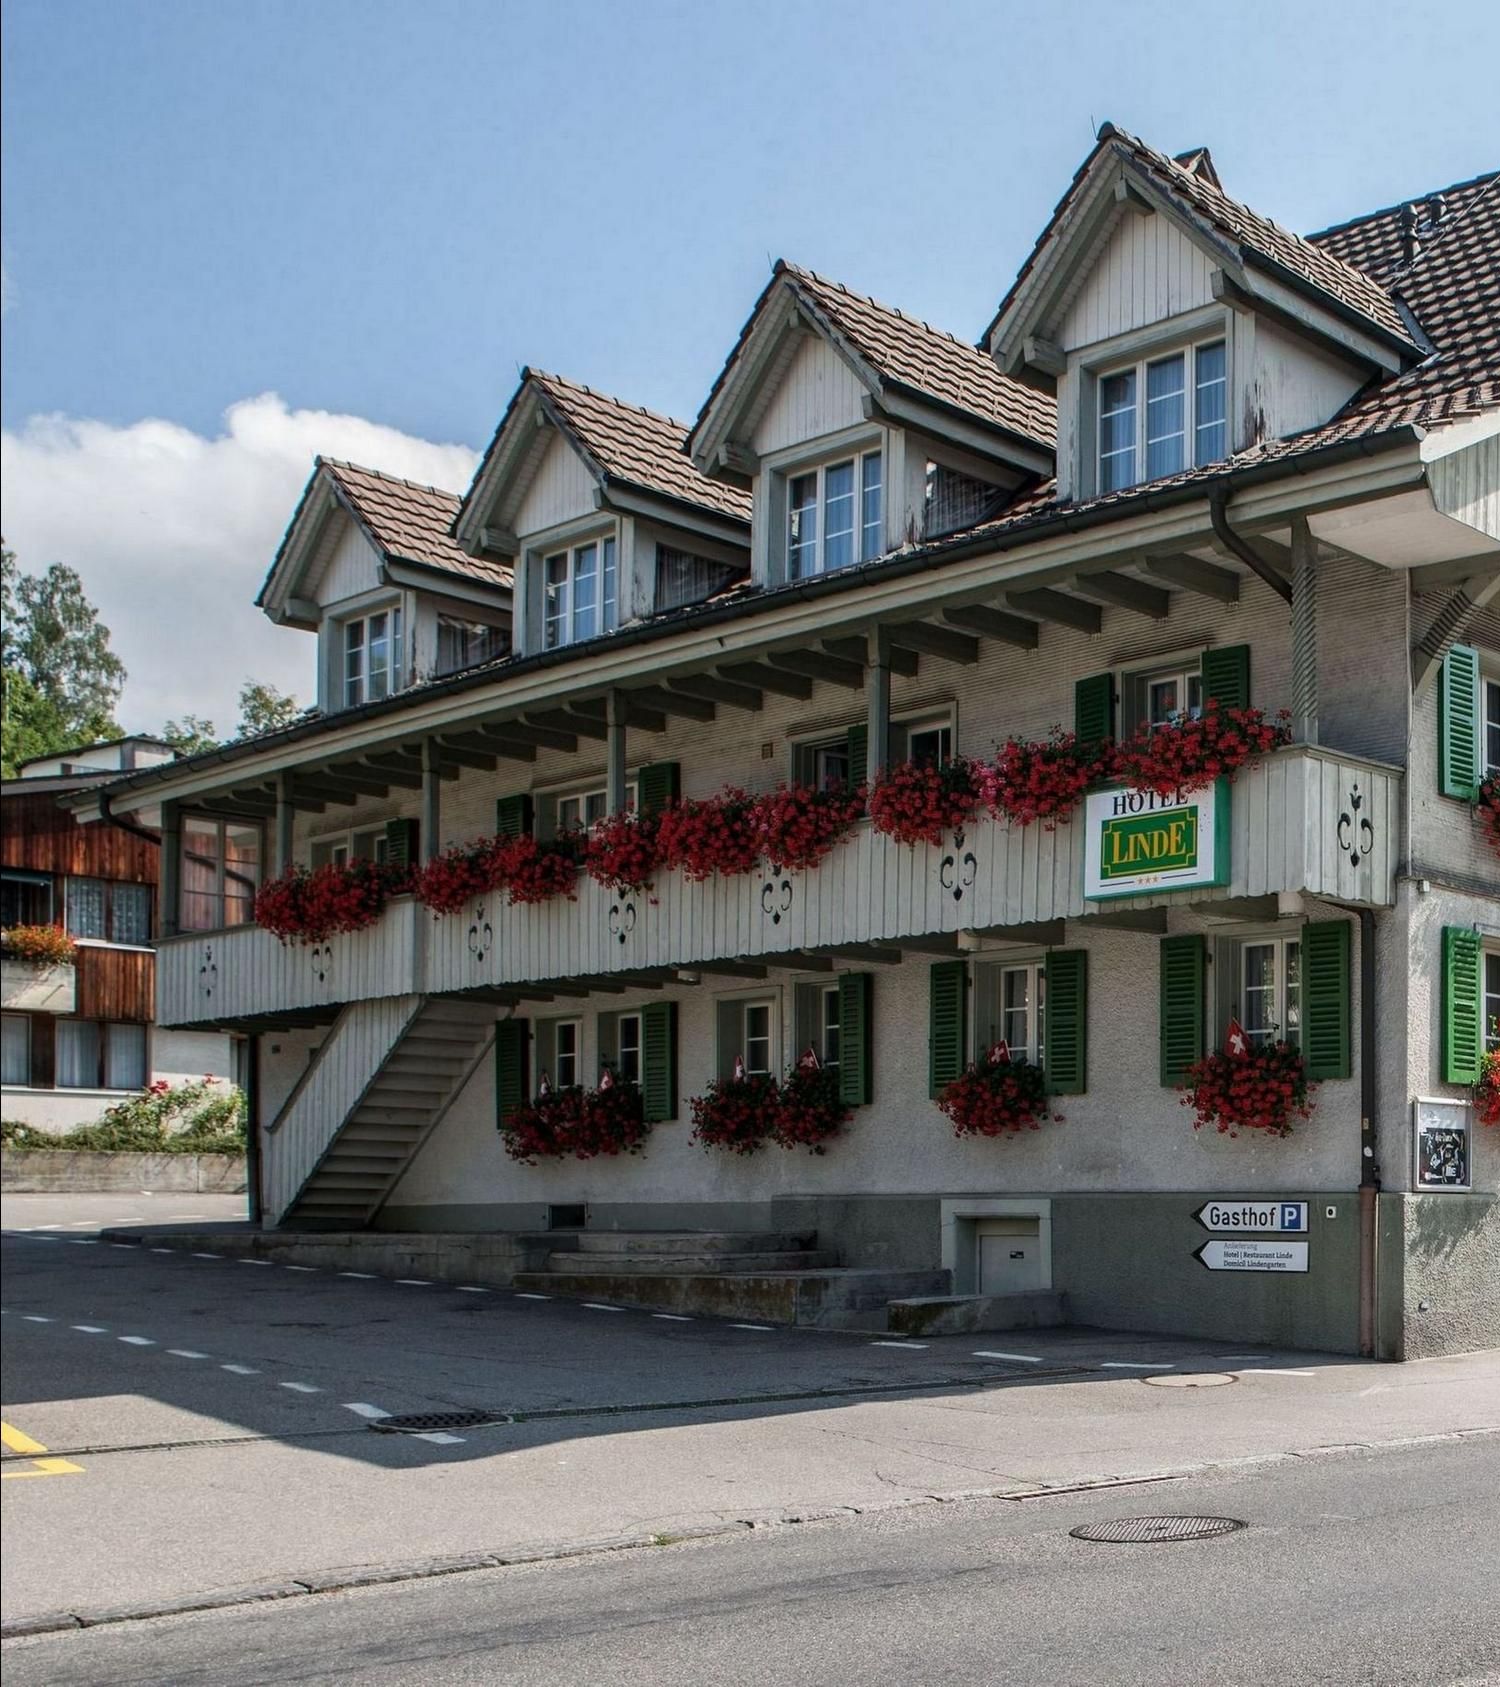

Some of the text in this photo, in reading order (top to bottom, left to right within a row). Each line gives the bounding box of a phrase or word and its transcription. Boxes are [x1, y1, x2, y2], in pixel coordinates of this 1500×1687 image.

[1112, 821, 1186, 864] LINDE
[1210, 1206, 1297, 1226] Gasthof P
